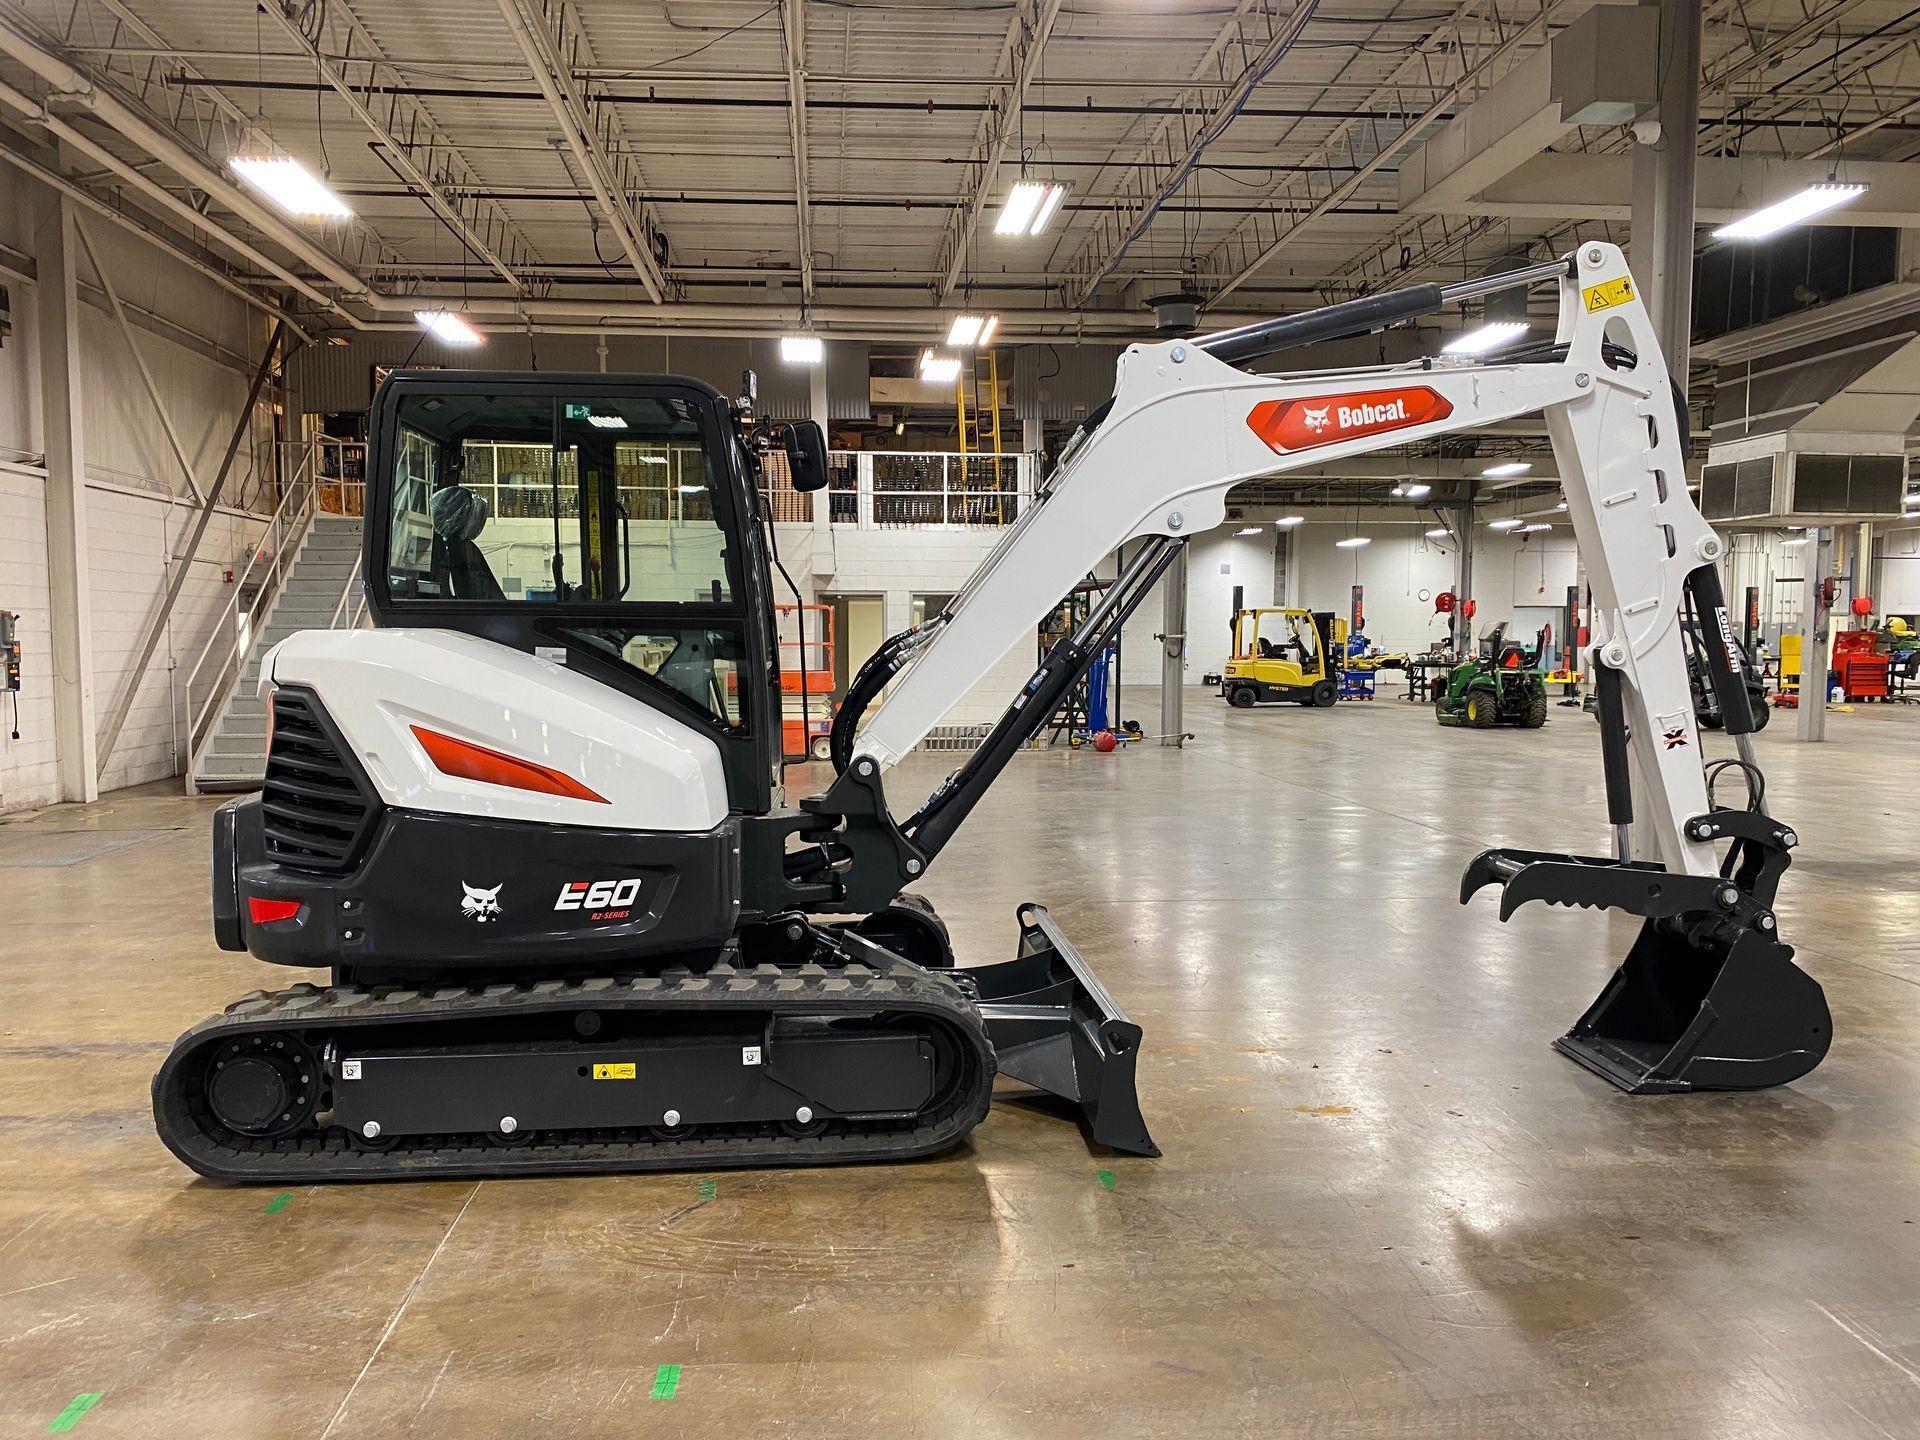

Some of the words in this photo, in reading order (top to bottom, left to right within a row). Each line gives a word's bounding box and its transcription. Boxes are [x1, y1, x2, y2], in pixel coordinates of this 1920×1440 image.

[1337, 398, 1405, 428] Bobcat
[1716, 606, 1740, 673] LongArm
[553, 878, 642, 911] E60
[591, 910, 630, 921] R2-SERIES
